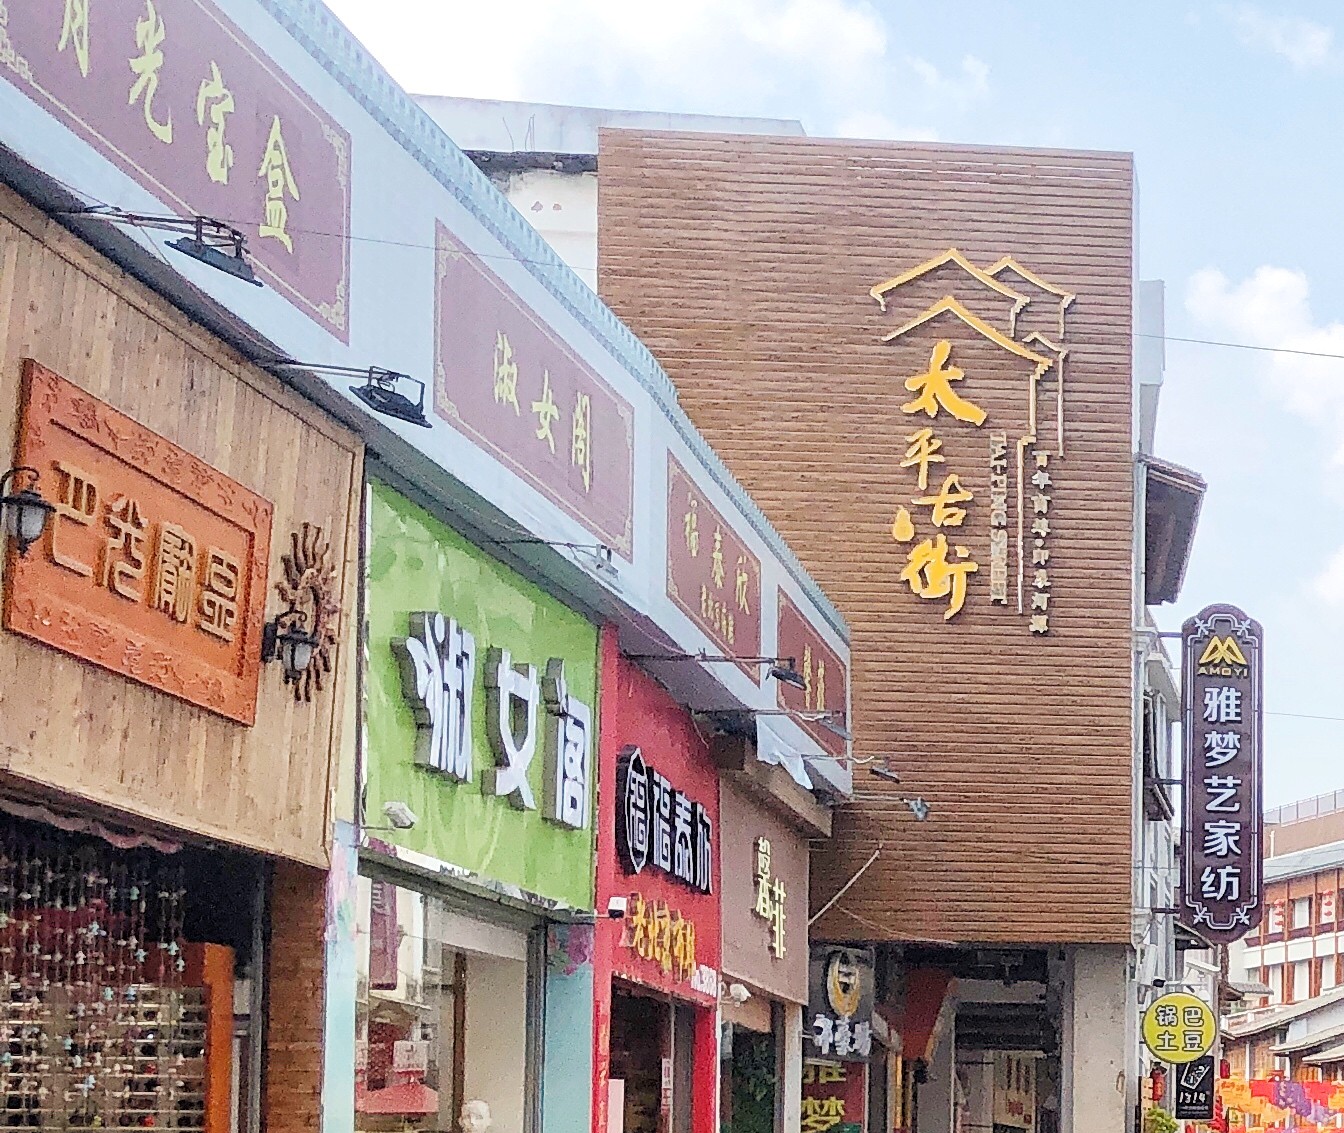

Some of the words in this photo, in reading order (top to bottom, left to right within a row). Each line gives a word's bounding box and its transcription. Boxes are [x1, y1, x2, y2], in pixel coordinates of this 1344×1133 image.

[900, 339, 988, 620] 太平古街
[1201, 686, 1242, 902] 雅梦艺家纺
[1156, 1004, 1205, 1028] 锅巴
[1156, 1031, 1205, 1052] 土豆
